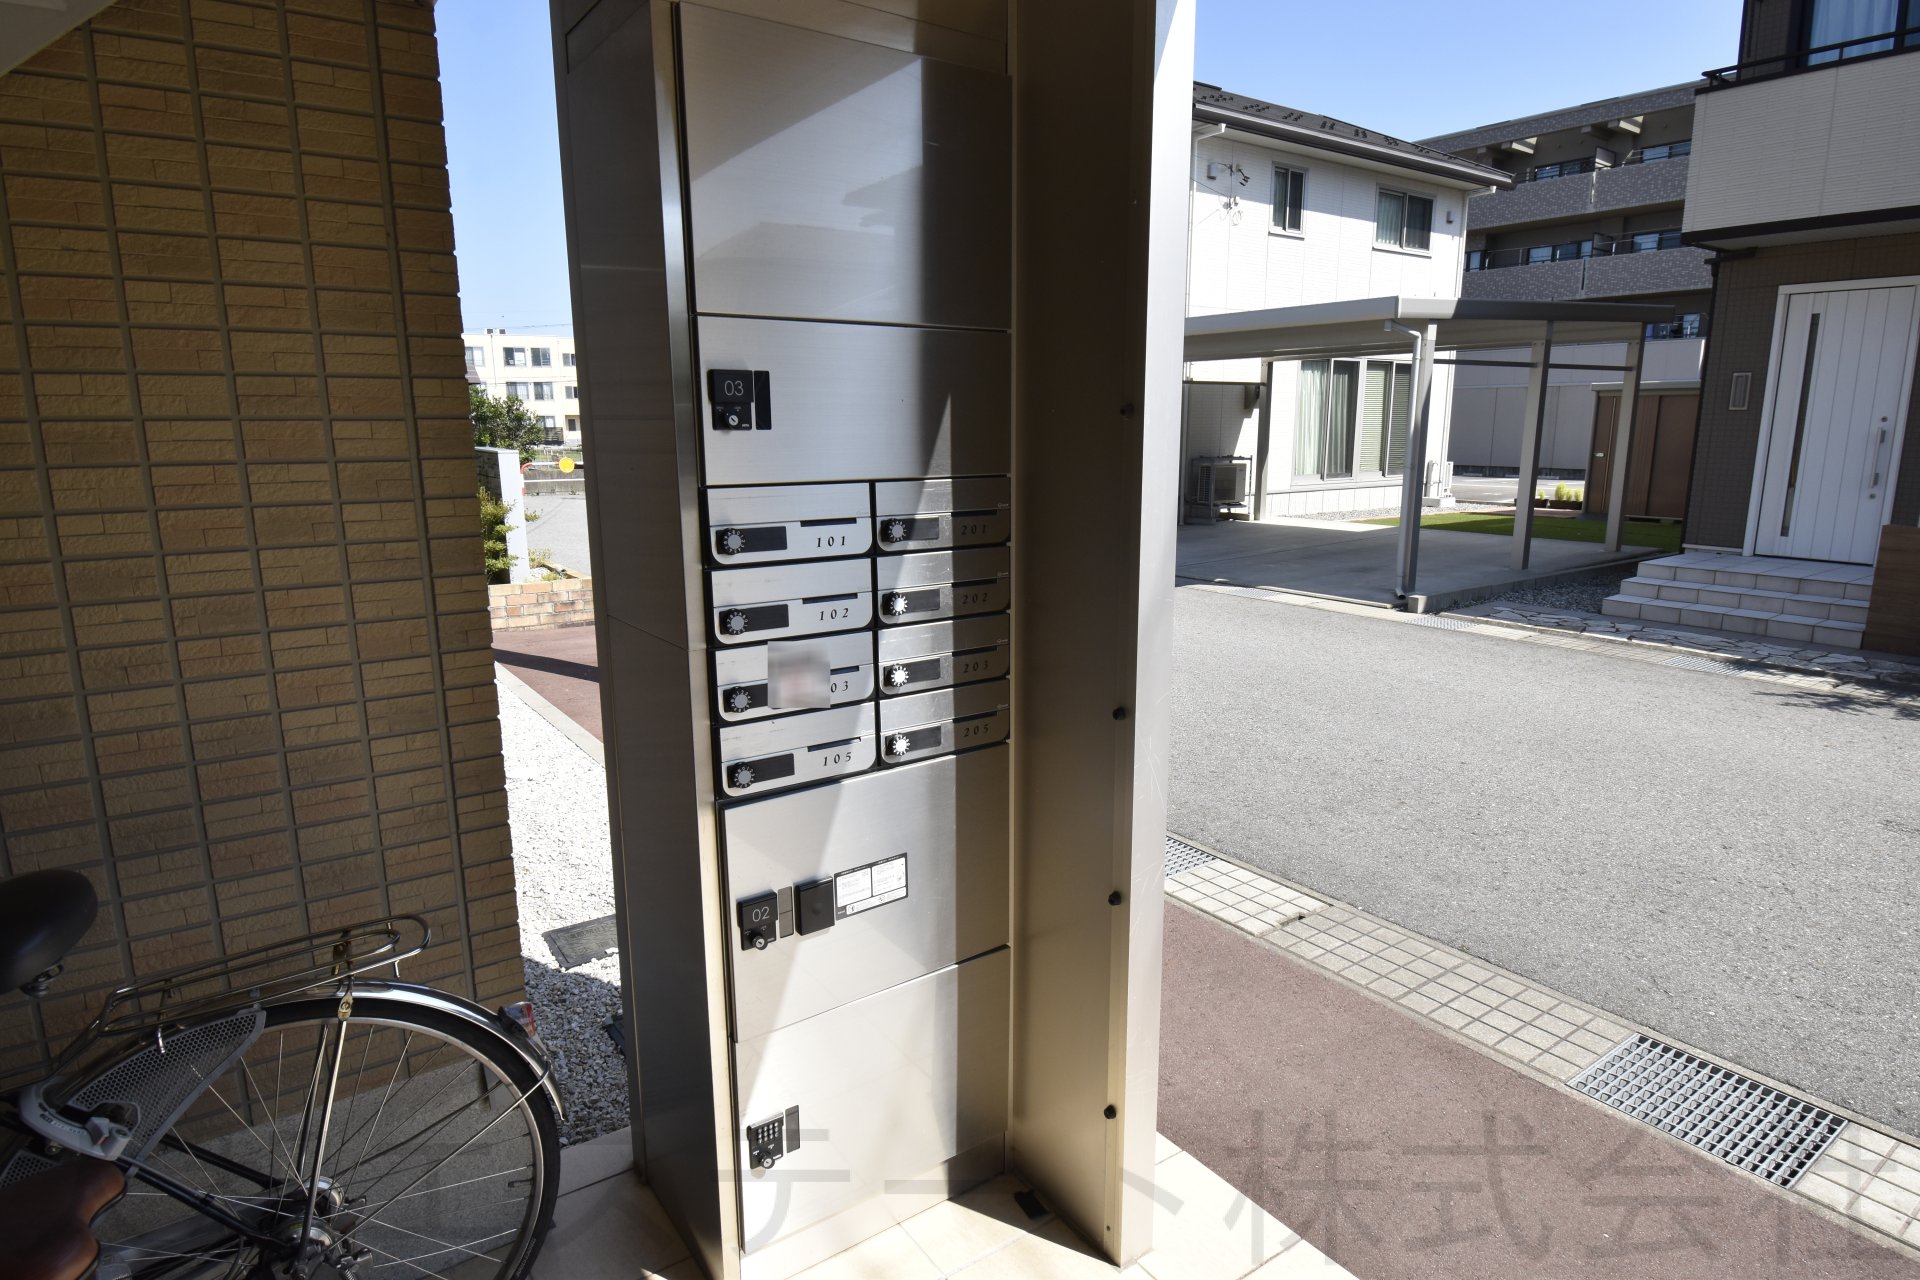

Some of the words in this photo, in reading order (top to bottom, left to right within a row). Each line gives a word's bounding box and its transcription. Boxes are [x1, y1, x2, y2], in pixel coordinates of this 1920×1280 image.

[724, 380, 744, 396] 03
[961, 523, 987, 536] 201
[816, 535, 846, 548] 101
[962, 592, 989, 604] 202
[819, 607, 849, 621] 102
[963, 661, 989, 673] 203
[964, 724, 989, 736] 205
[822, 752, 853, 767] 105
[752, 906, 770, 922] 02
